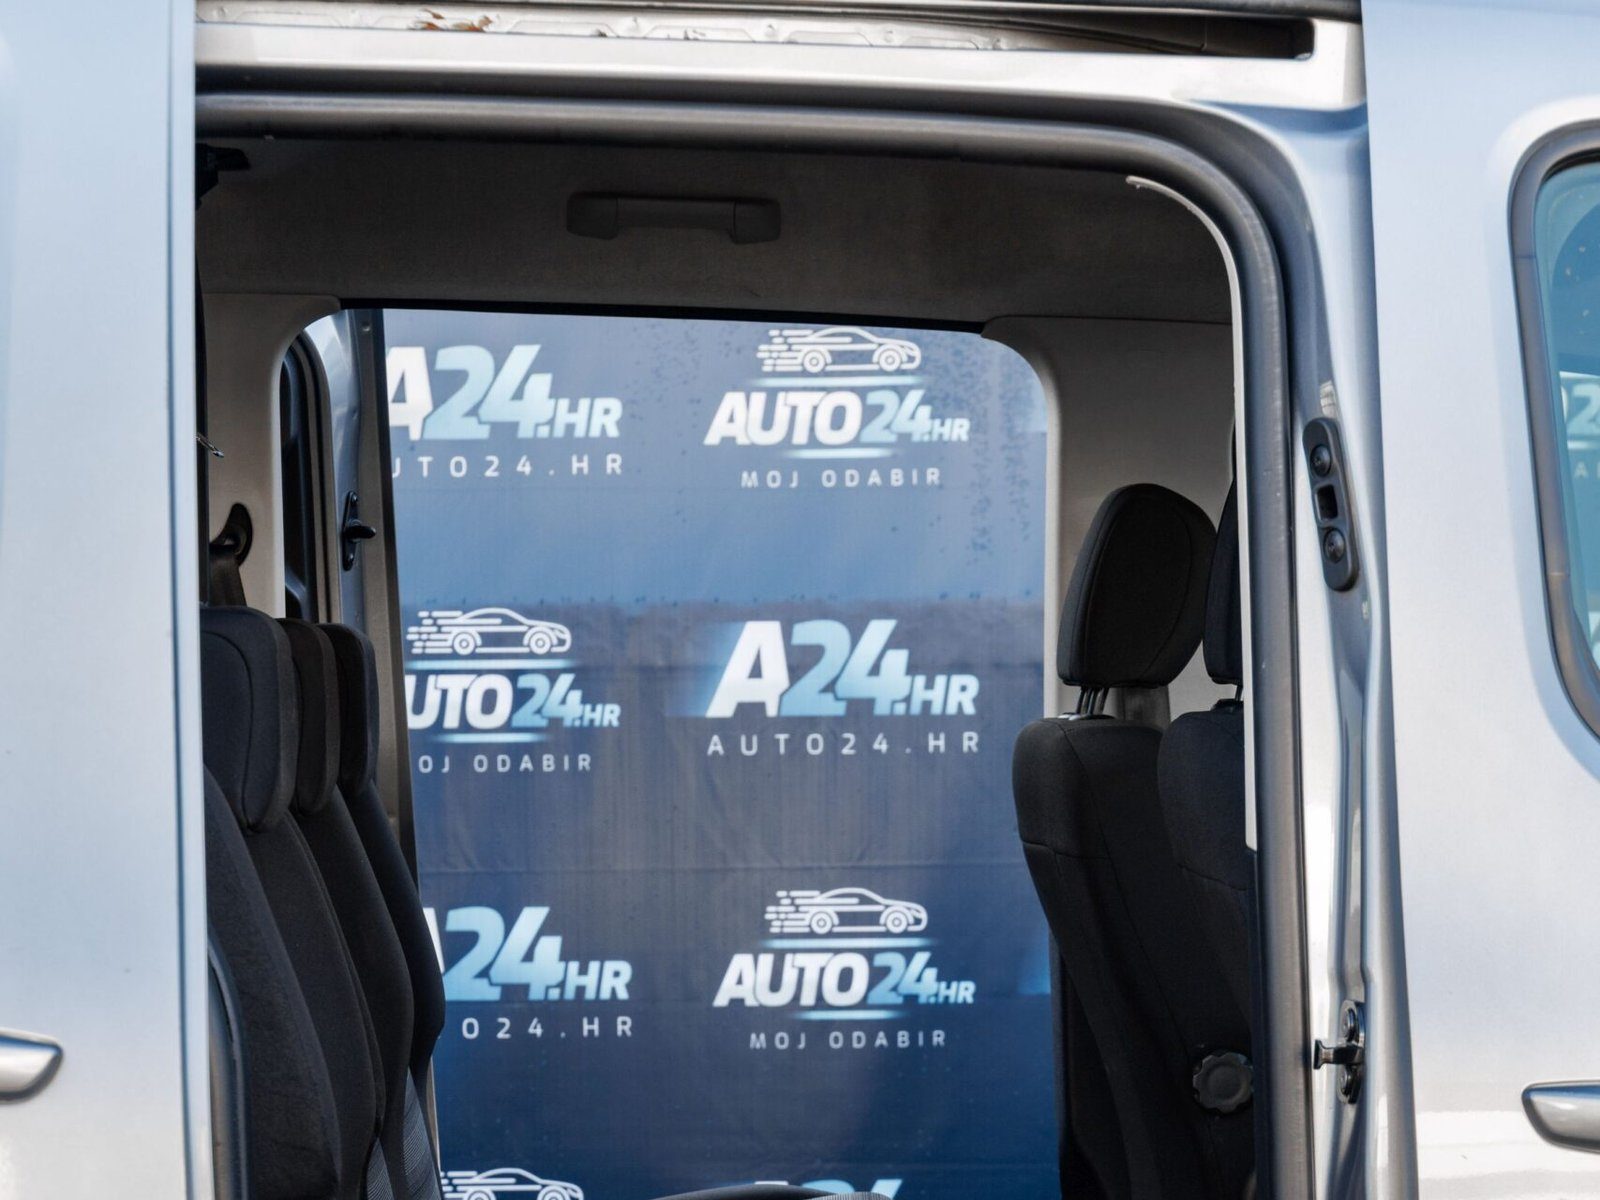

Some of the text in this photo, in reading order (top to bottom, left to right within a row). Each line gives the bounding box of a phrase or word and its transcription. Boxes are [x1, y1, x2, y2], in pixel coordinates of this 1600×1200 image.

[386, 344, 623, 441] A24.HR
[703, 389, 971, 445] AUTO24.HR
[741, 467, 941, 488] MOJ ODABIR
[705, 618, 980, 719] A24.HR
[473, 753, 592, 773] ODABIR
[706, 731, 980, 756] AUTO24.HR
[712, 951, 976, 1007] AUTO24.HR
[750, 1030, 946, 1050] MOJ ODABIR
